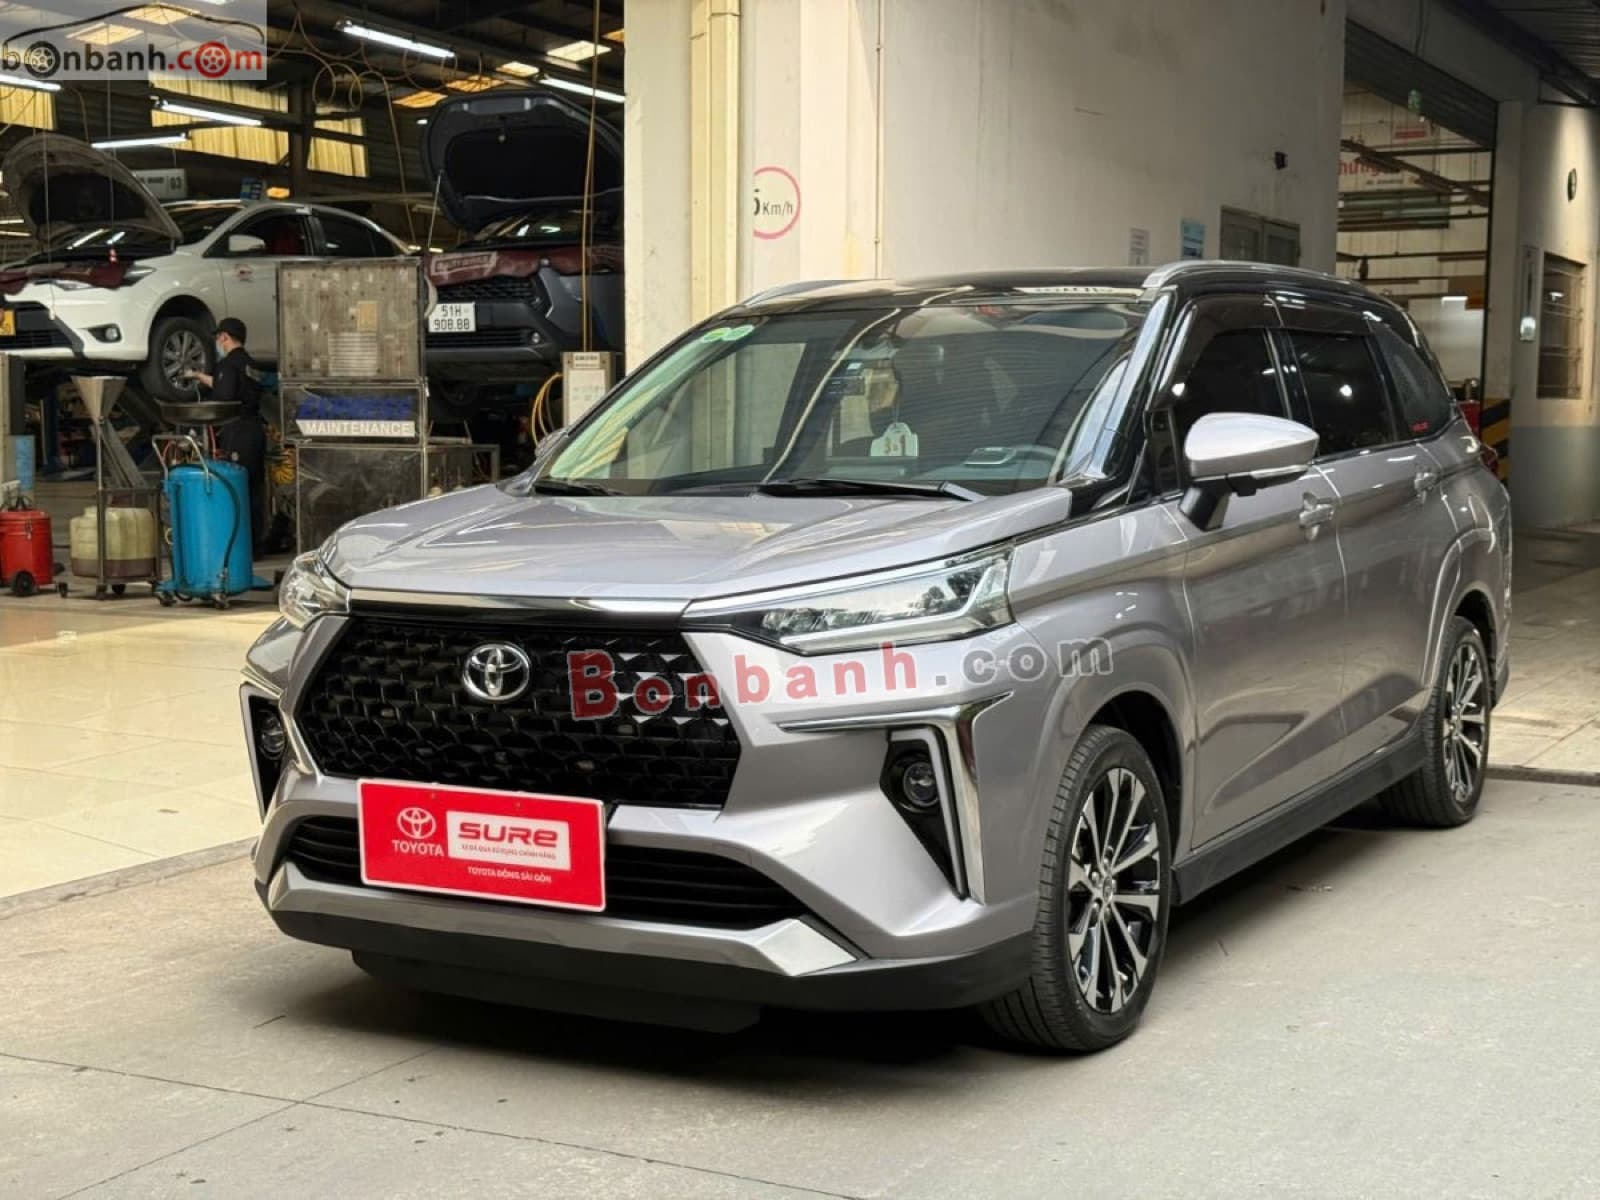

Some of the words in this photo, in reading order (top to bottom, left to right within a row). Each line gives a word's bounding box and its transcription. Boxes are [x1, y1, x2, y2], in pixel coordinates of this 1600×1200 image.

[762, 201, 794, 217] Km/h
[440, 304, 462, 318] 51H
[305, 421, 411, 435] MAINTENANCE
[391, 839, 445, 857] TOYOTA
[467, 866, 497, 878] TOYOTA
